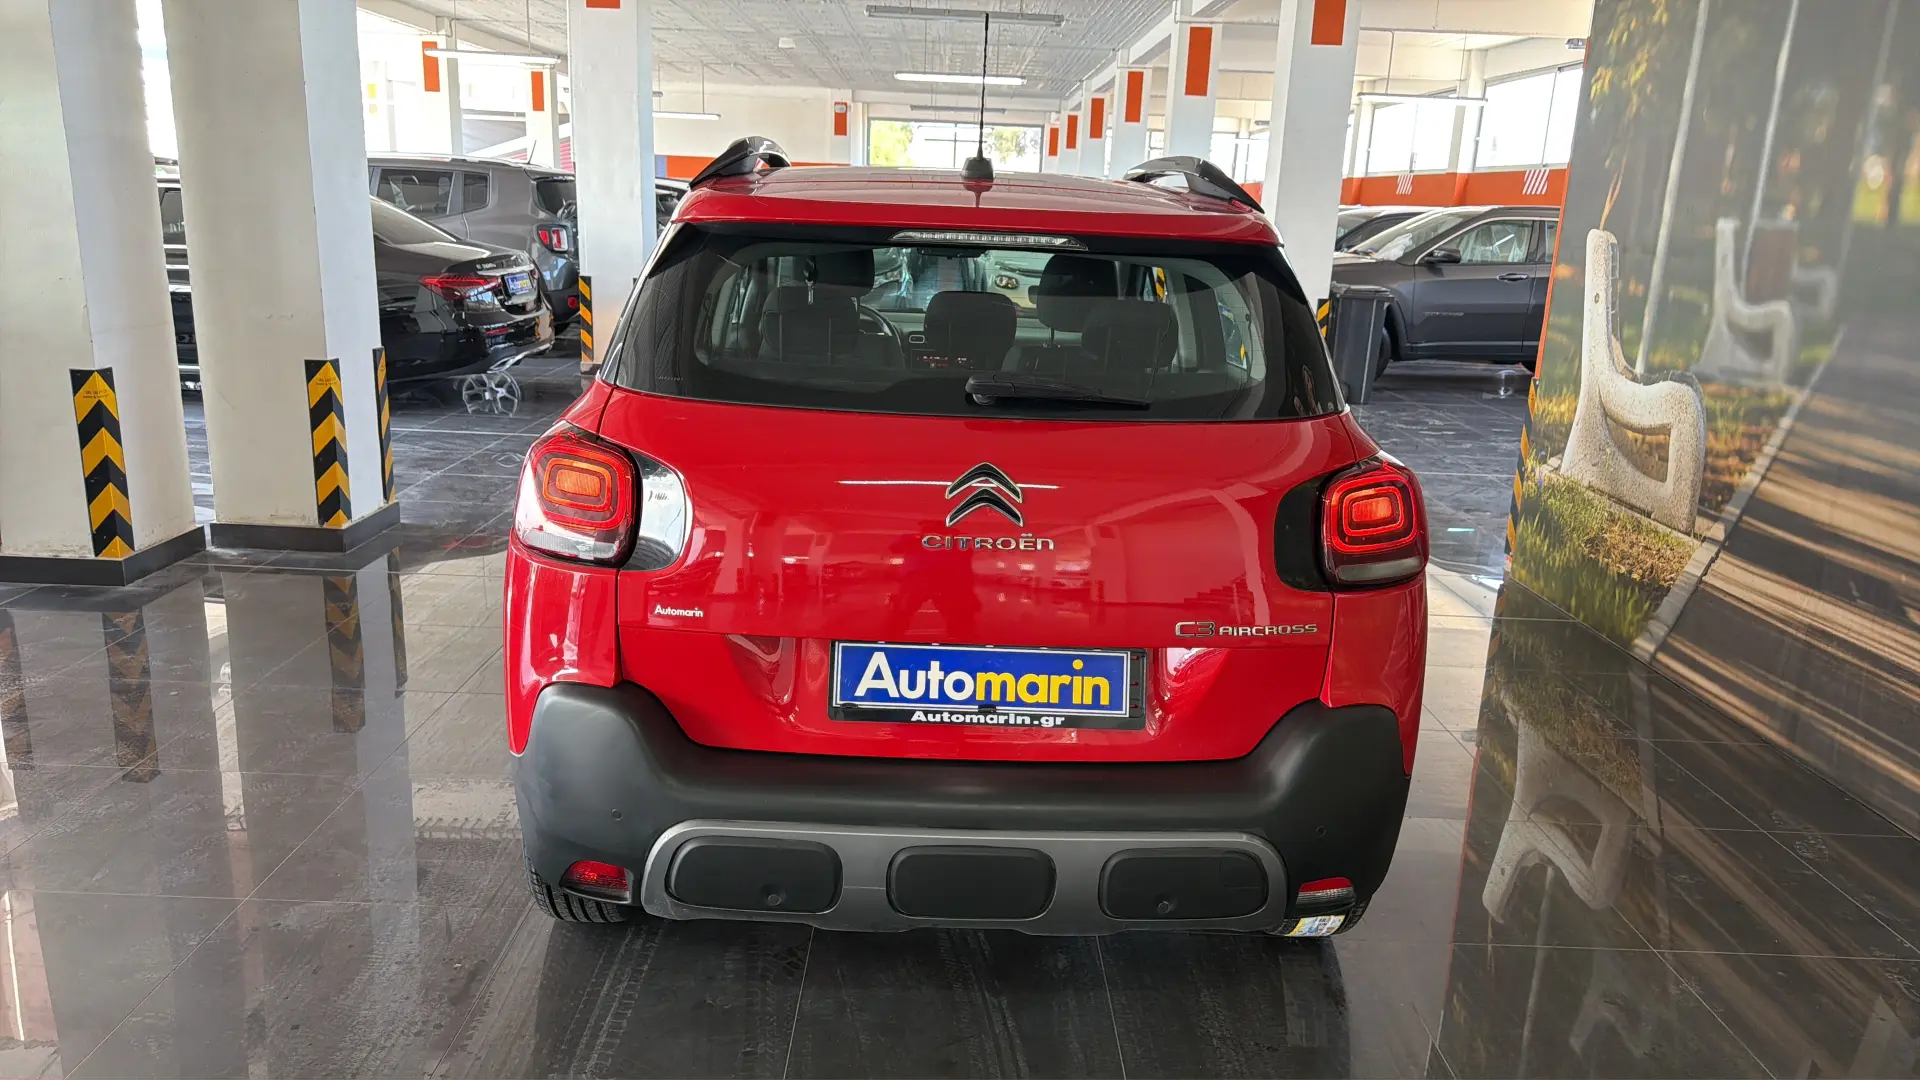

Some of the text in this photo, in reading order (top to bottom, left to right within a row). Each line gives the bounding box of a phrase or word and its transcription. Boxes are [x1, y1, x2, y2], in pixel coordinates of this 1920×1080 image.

[921, 533, 1055, 551] CITROËN
[654, 604, 704, 618] Automarin
[1175, 621, 1318, 638] C3 AIRCROSS
[853, 651, 1111, 706] Automarin
[910, 710, 1066, 728] Automarin.gr
